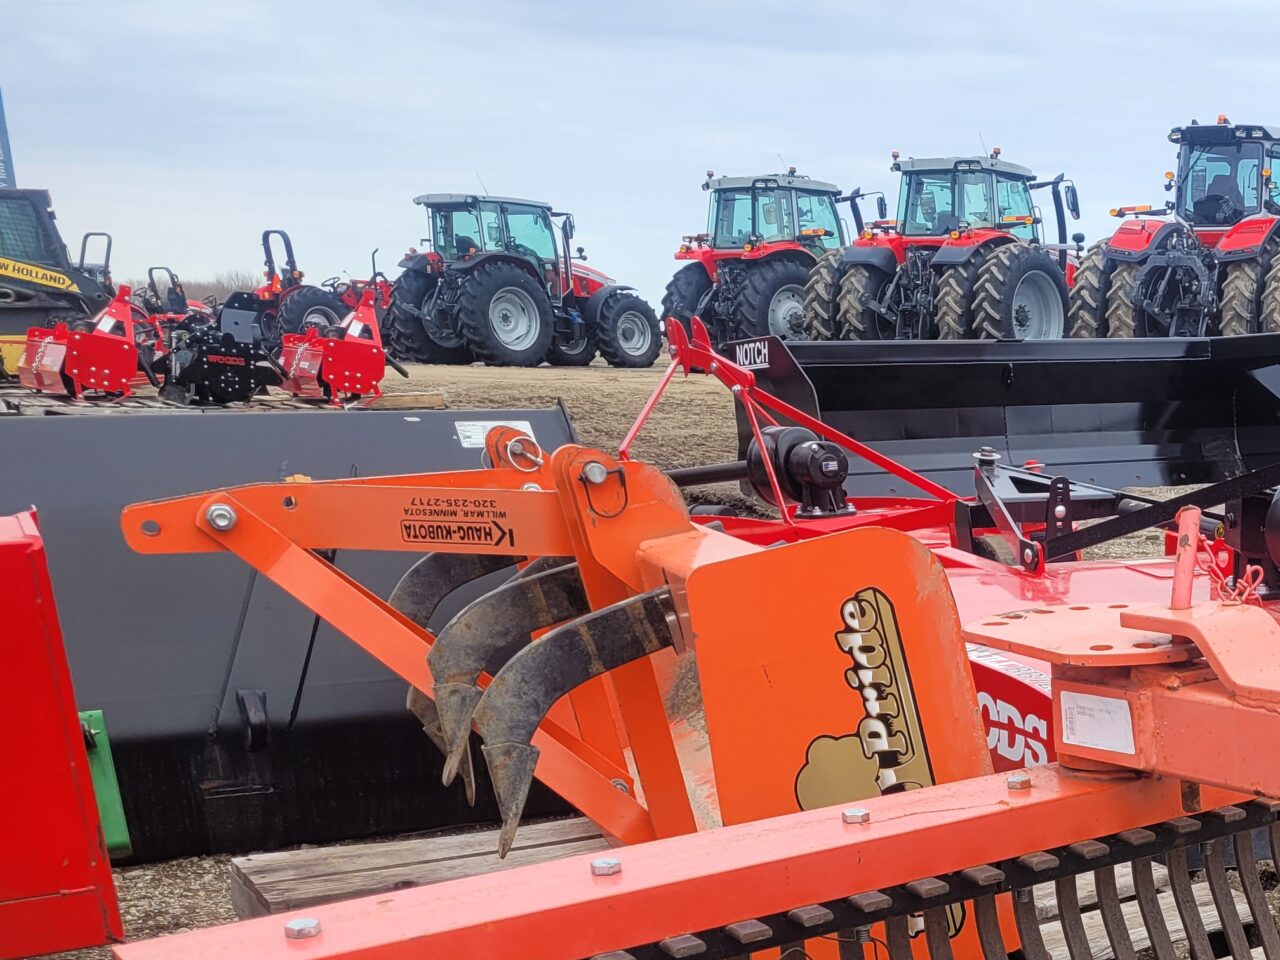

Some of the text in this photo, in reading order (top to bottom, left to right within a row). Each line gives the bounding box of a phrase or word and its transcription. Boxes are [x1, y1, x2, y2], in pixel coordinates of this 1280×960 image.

[12, 264, 67, 285] HOLLAND
[207, 354, 246, 366] WOODS
[736, 340, 769, 367] NOTCH
[403, 506, 507, 519] WILLMAR, MINNESOTA
[410, 497, 498, 509] 320-235-2717
[403, 523, 494, 542] HAUG-KUBOTA
[834, 596, 909, 759] Pride
